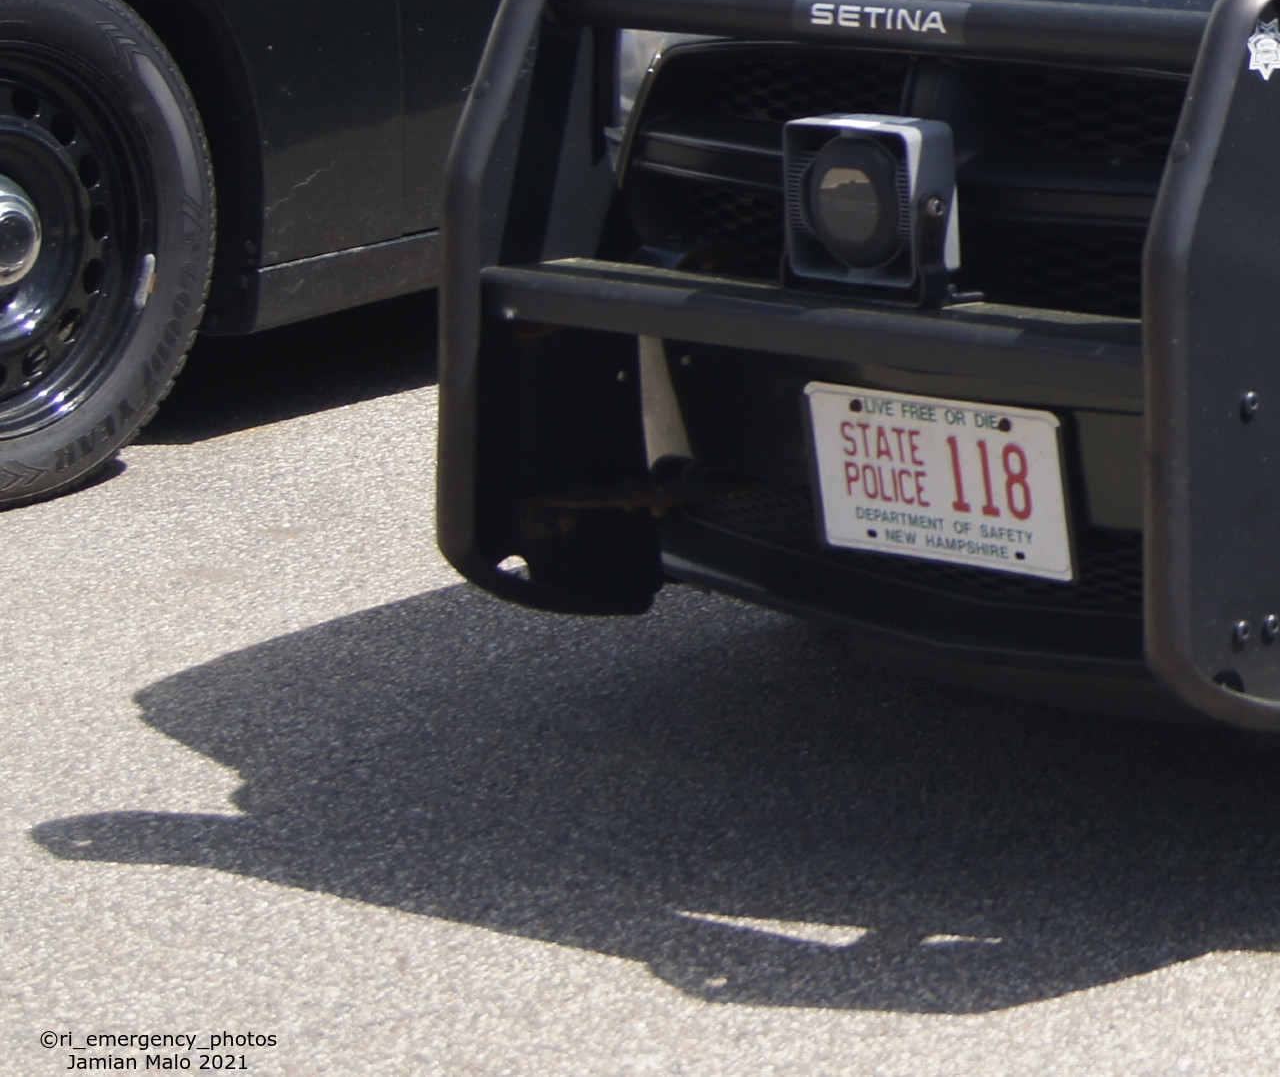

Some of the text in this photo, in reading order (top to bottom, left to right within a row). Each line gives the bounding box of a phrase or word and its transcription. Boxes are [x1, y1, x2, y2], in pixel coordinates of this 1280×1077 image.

[811, 2, 947, 34] SETINA
[864, 397, 1000, 430] LIVE FREE OR DIE
[840, 421, 925, 467] STATE
[843, 461, 931, 508] POLICE
[946, 435, 1034, 521] 118
[855, 505, 1034, 545] DEPARTMENT OF SAFETY
[885, 527, 1010, 560] NEW HAMPSHIRE
